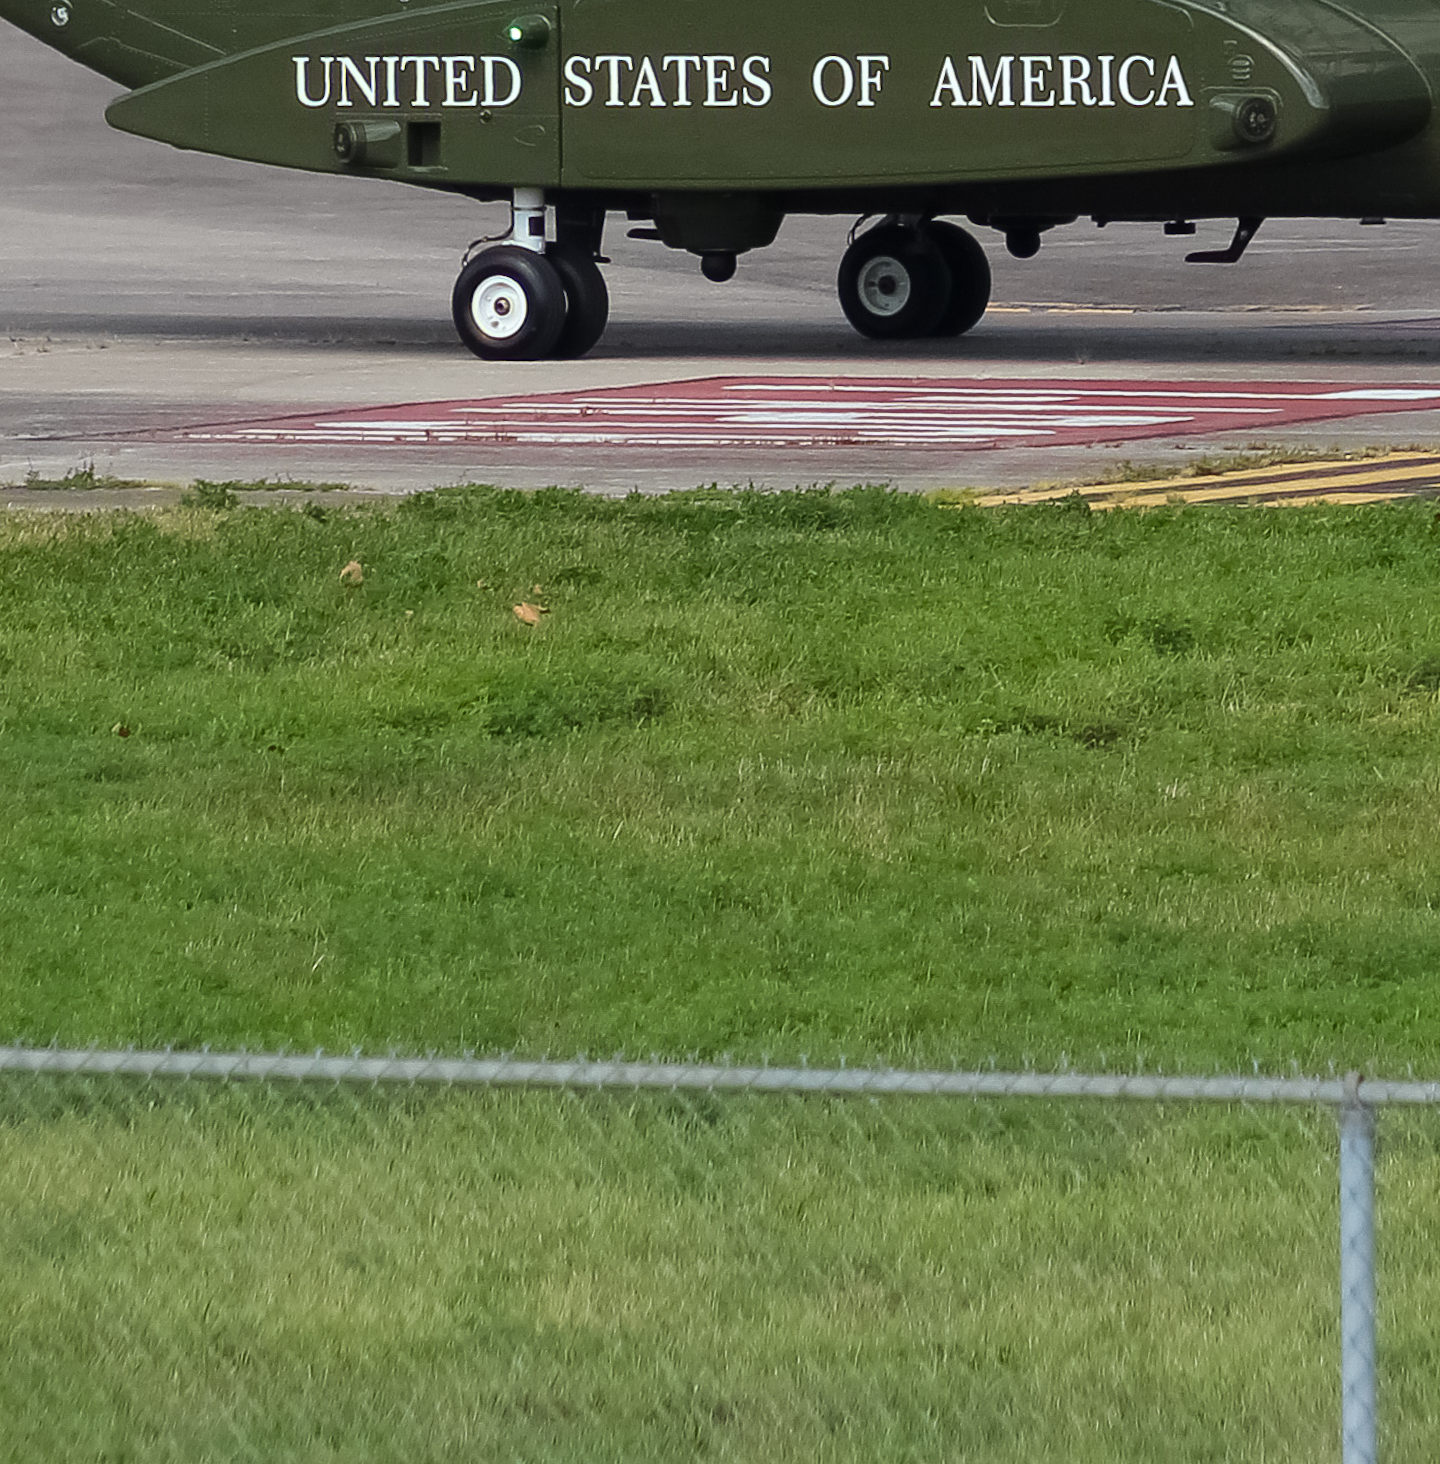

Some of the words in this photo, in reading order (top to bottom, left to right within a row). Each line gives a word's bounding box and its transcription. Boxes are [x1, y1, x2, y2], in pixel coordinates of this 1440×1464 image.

[292, 55, 523, 108] UNITED
[563, 55, 772, 108] STATES
[812, 55, 890, 108] OF
[929, 55, 1195, 108] AMERICA
